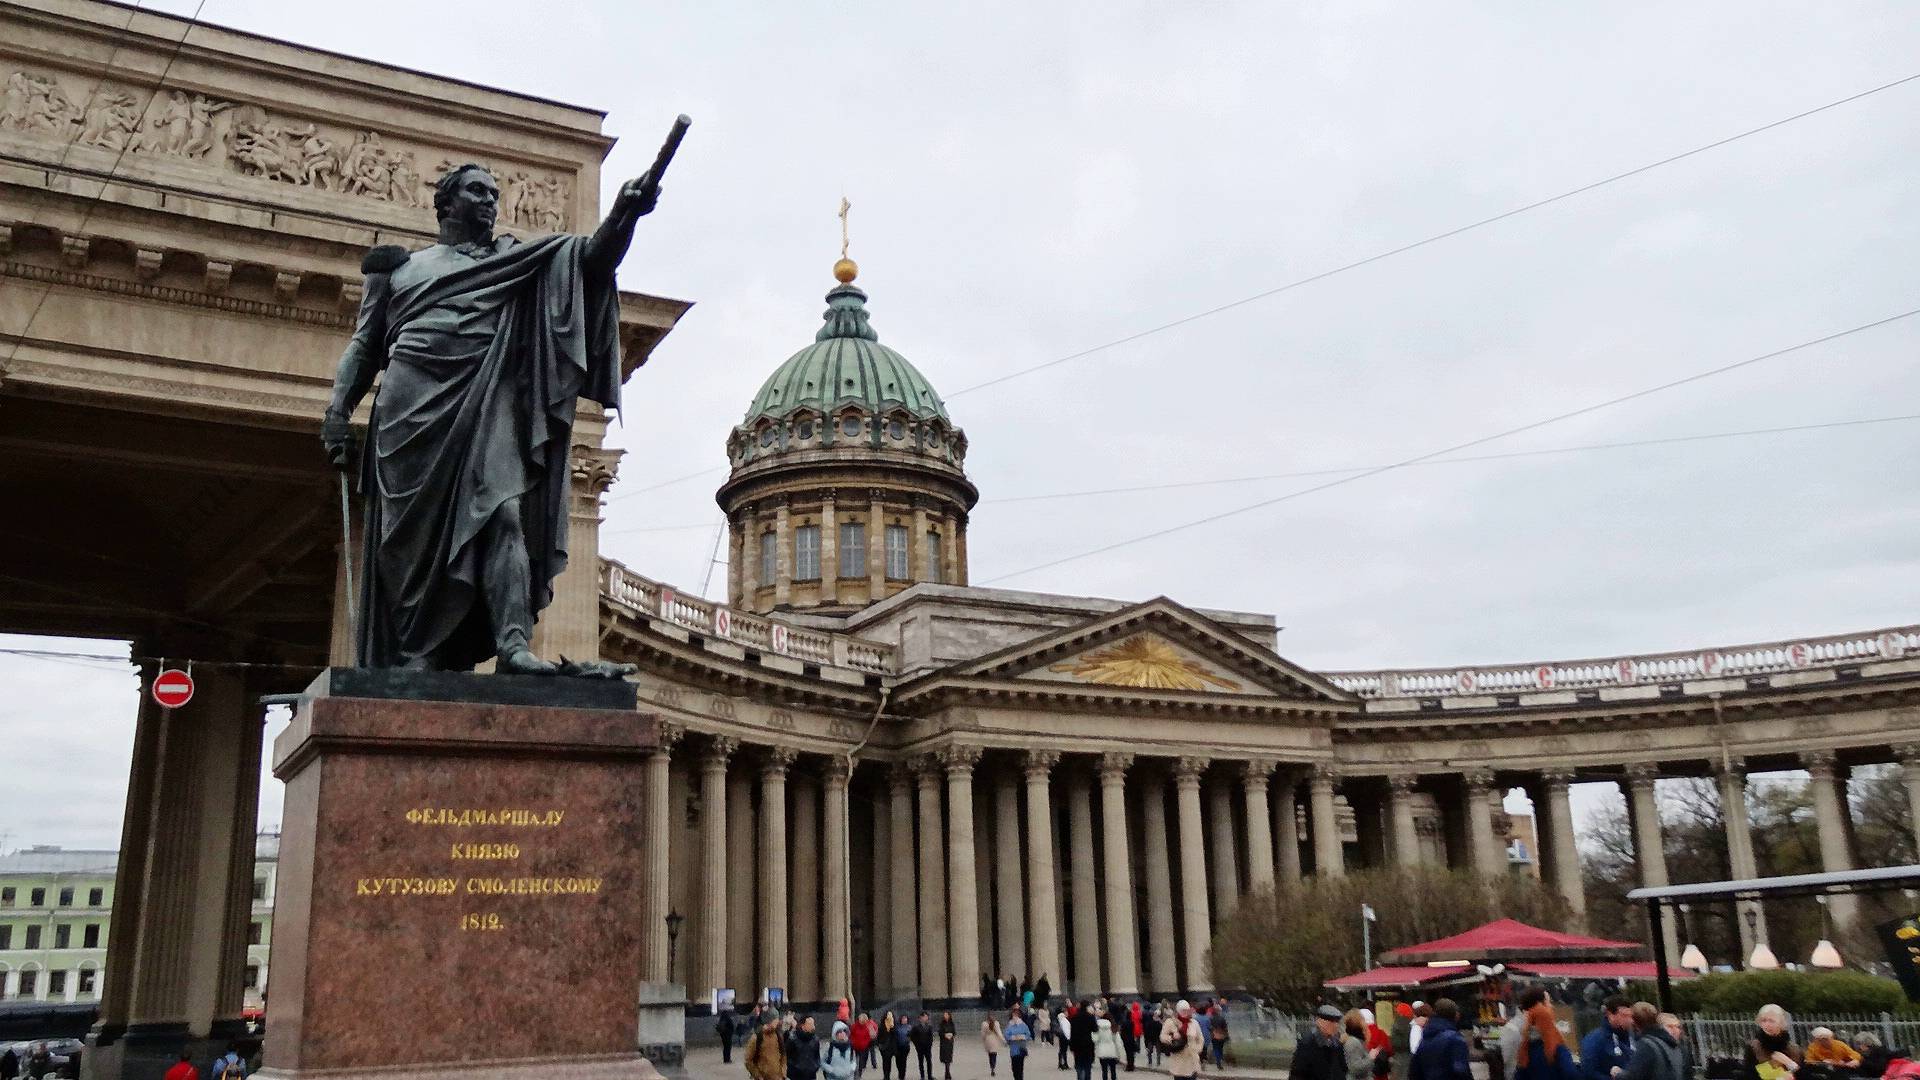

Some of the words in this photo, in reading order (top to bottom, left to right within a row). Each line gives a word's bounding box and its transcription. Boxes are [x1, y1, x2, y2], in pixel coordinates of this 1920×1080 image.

[404, 807, 565, 827] ФЕЛЬДМАРШАЛУ
[451, 841, 520, 860] КНЯЗЮ
[356, 877, 459, 896] КУТУЗОВУ
[466, 877, 602, 896] СМОЛЕНСКОМУ
